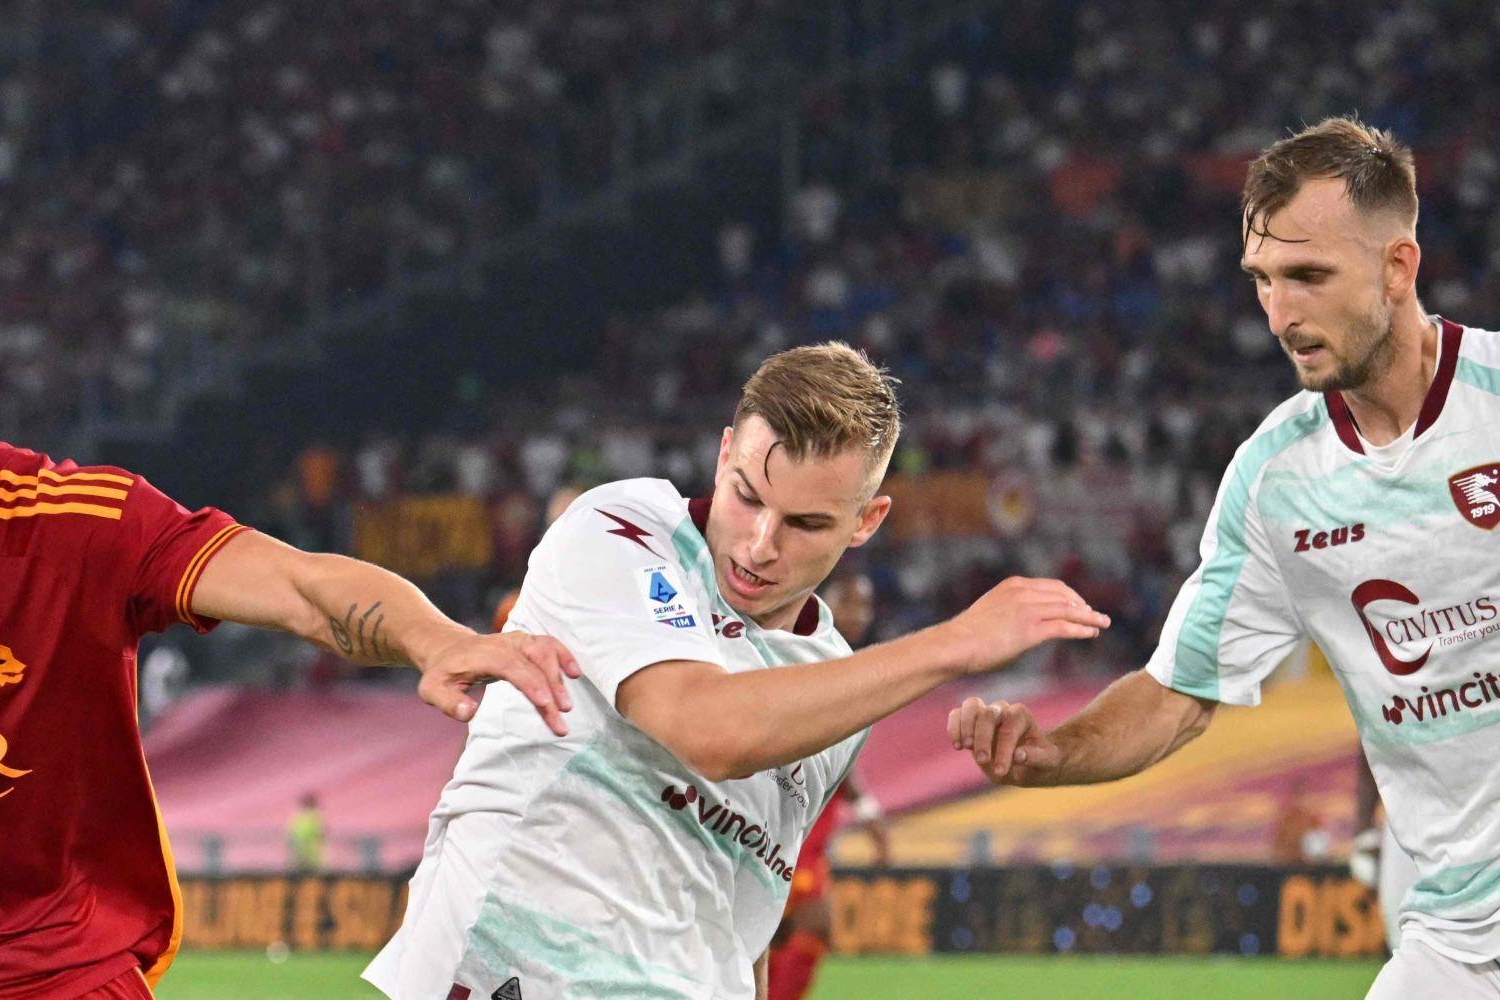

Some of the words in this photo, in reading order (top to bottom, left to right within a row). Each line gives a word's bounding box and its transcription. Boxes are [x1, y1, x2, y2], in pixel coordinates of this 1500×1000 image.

[1469, 503, 1496, 519] 1919
[653, 604, 676, 615] SERIE
[677, 603, 684, 611] A
[1385, 596, 1498, 646] CIVITUS
[1437, 630, 1477, 648] Transfer
[1480, 624, 1500, 639] you
[1404, 672, 1500, 722] vincit
[830, 875, 938, 954] ORE
[1278, 873, 1389, 957] DIS
